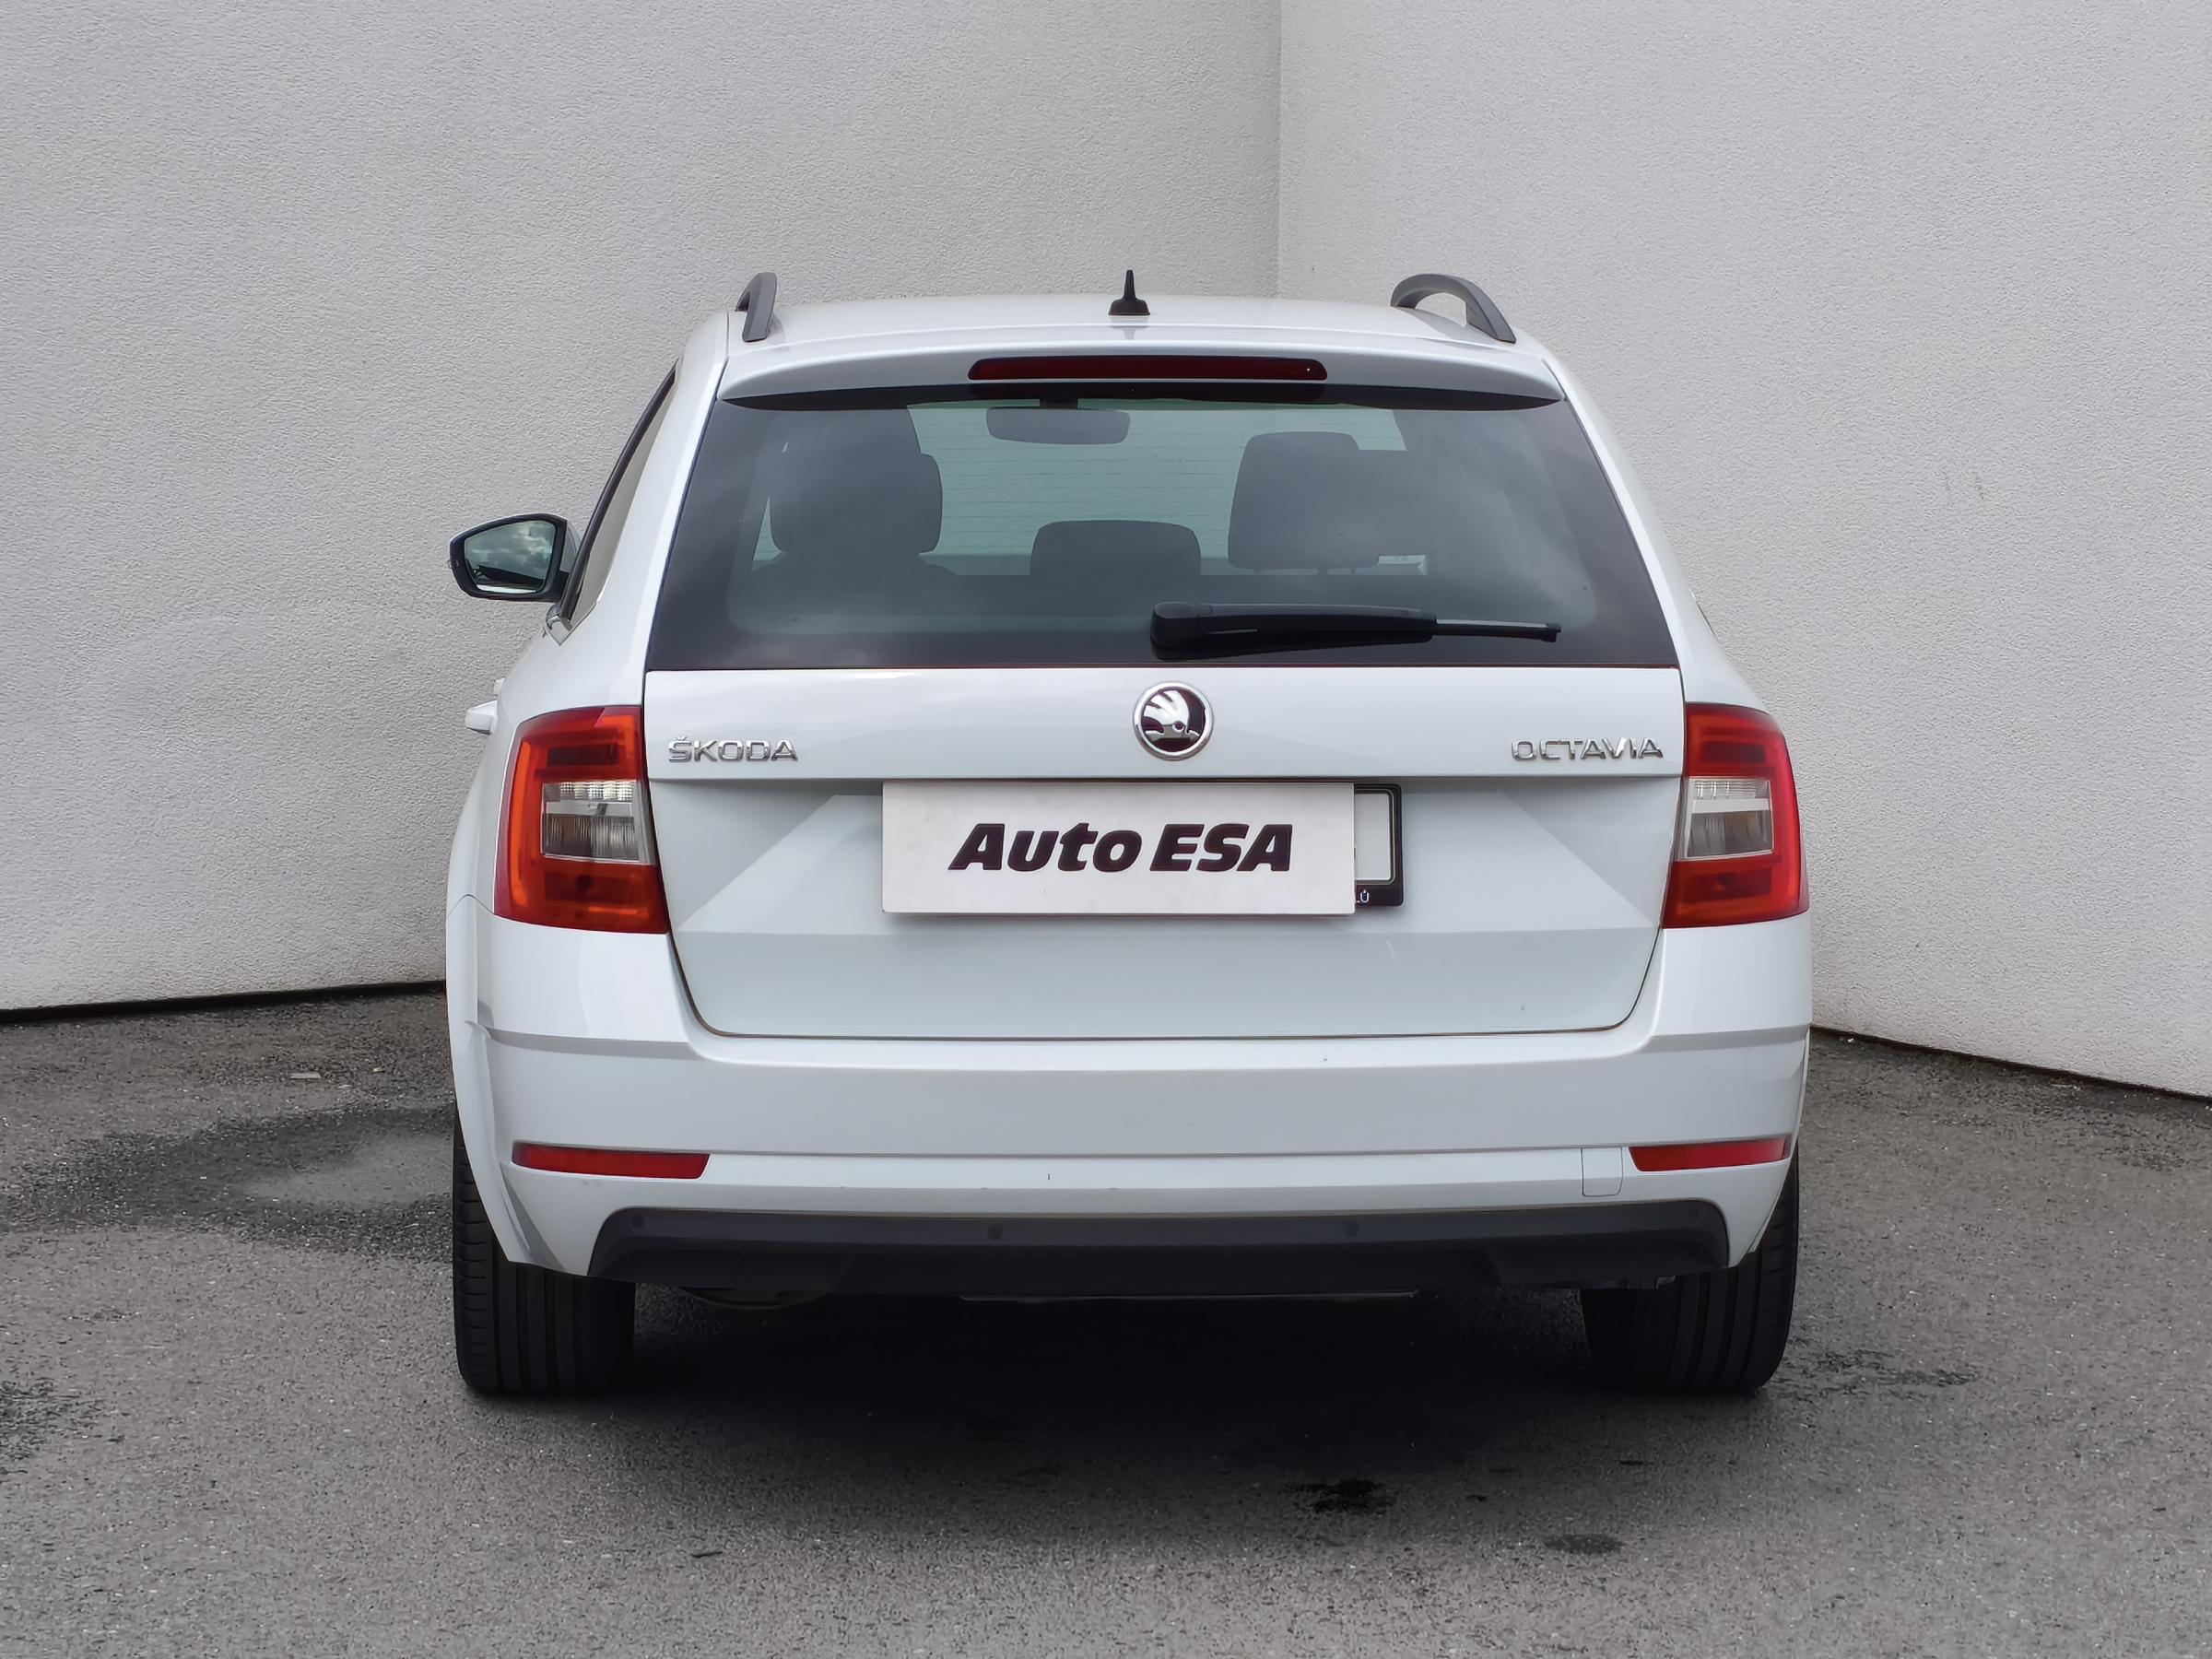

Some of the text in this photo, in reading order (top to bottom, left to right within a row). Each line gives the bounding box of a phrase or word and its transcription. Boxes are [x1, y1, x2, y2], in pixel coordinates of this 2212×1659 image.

[668, 735, 798, 762] ŠKODA
[1512, 737, 1664, 760] OCTAVIA
[947, 822, 1293, 873] Auto ESA
